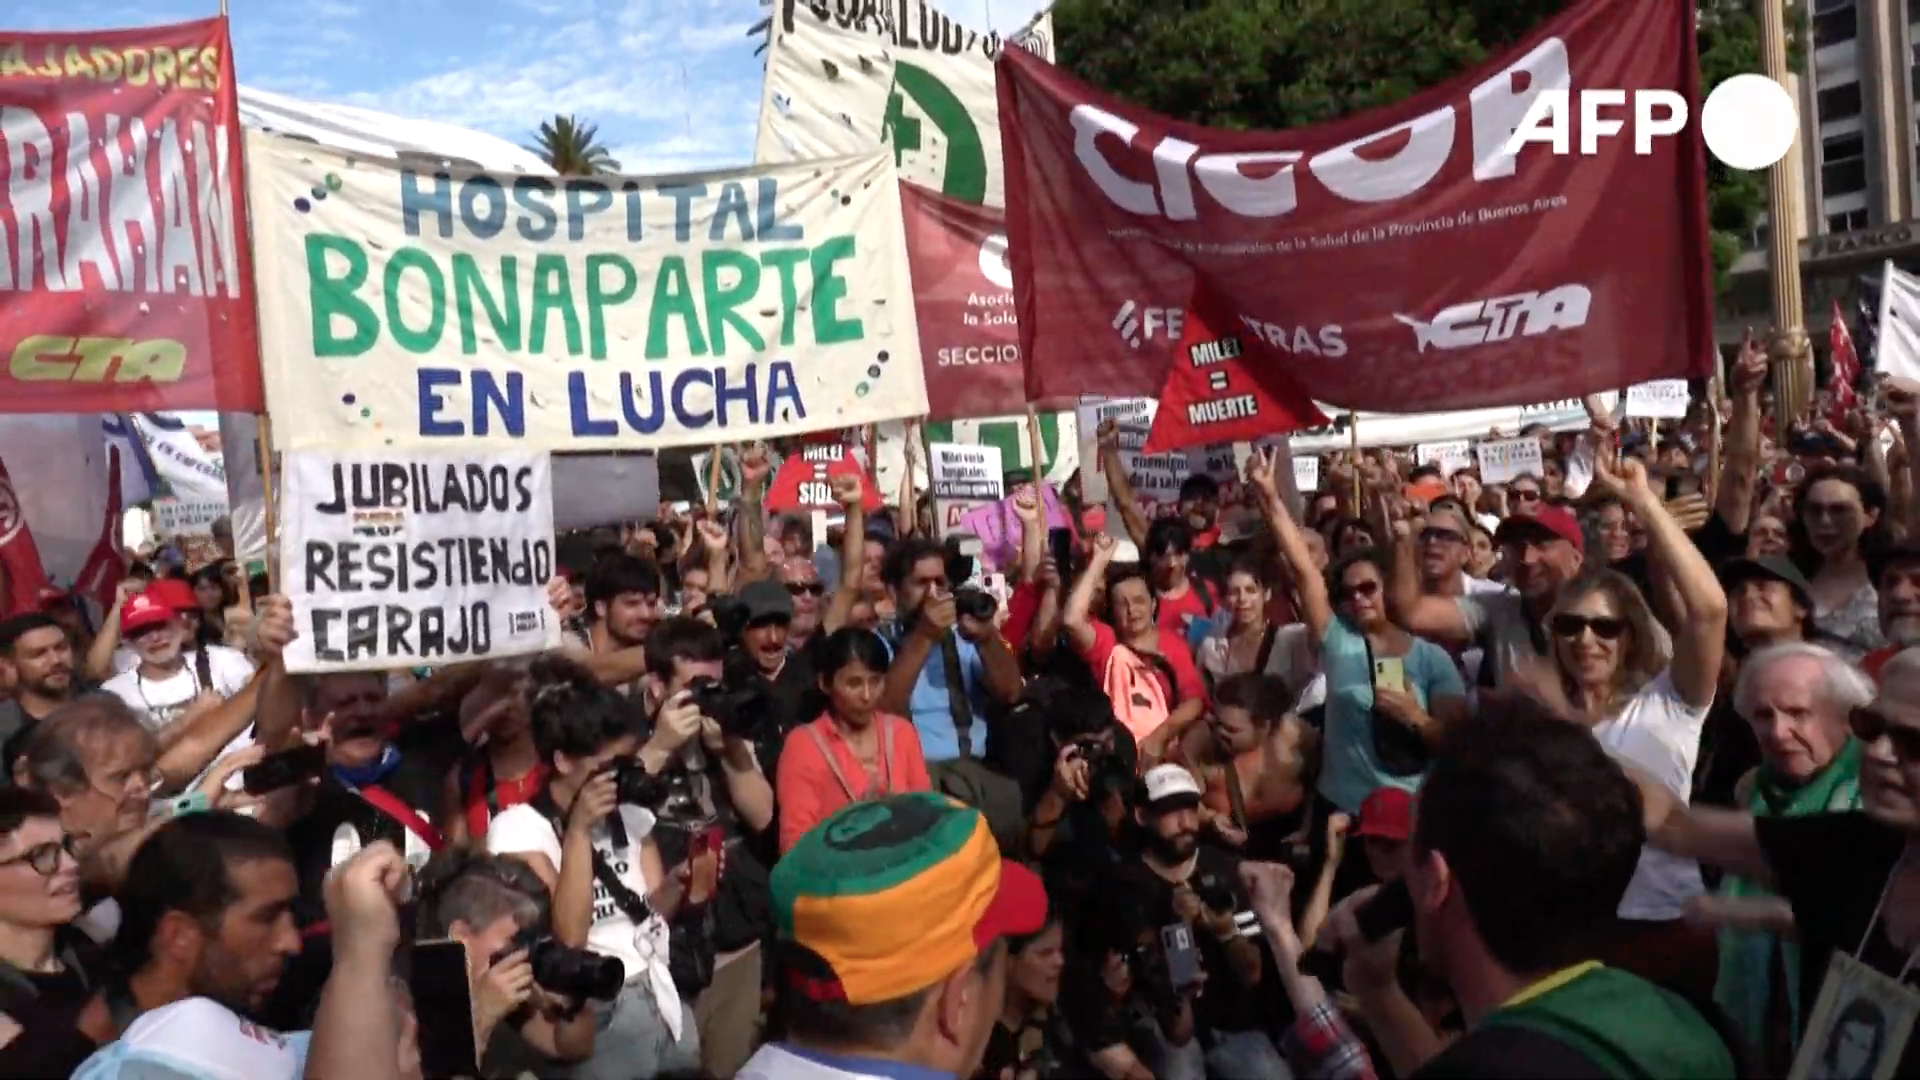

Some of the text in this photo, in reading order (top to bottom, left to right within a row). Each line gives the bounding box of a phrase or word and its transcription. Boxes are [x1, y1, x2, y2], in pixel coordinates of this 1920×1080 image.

[1070, 36, 1571, 221] CICOP
[0, 105, 240, 299] RAHAN
[1310, 230, 1348, 247] Salud
[1352, 229, 1369, 243] de
[1373, 227, 1385, 241] la
[1388, 216, 1454, 236] Provincia
[1458, 210, 1475, 226] de
[1478, 203, 1529, 222] Buenos
[1533, 194, 1568, 210] Aires
[304, 233, 864, 359] BONAPARTE
[984, 311, 1017, 326] Salu
[1426, 284, 1592, 350] CTA
[9, 335, 187, 384] CTA
[938, 344, 1022, 367] SECCIO
[1191, 338, 1241, 367] MILEI
[418, 361, 806, 438] EN LUCHA
[1188, 394, 1258, 425] MUERTE
[803, 443, 842, 462] MILEI
[315, 462, 533, 514] JUBILADOS
[310, 600, 491, 662] CARAJO
